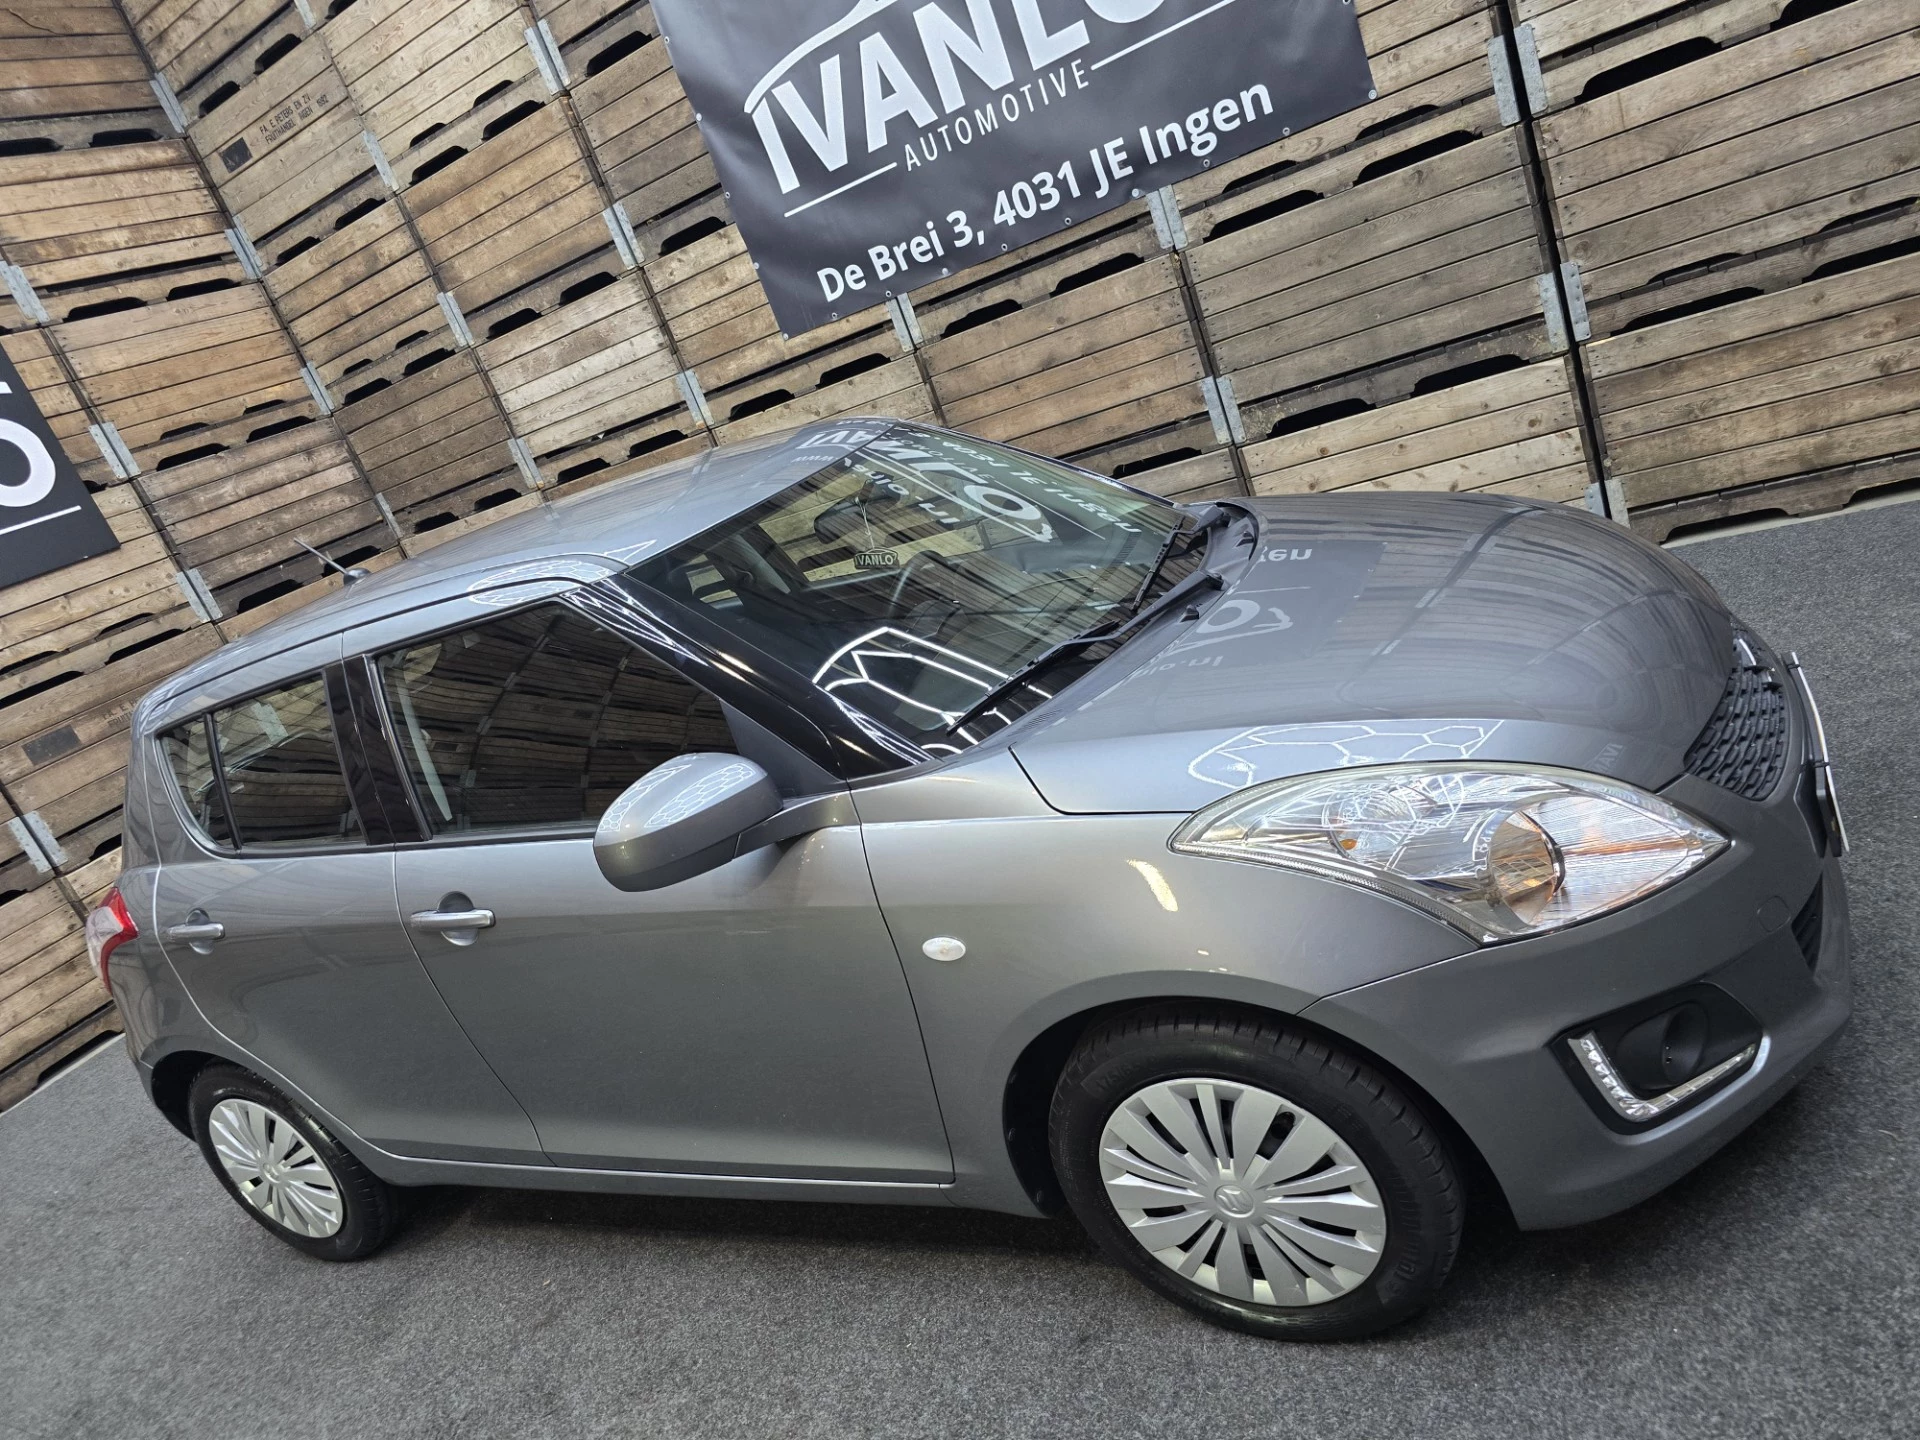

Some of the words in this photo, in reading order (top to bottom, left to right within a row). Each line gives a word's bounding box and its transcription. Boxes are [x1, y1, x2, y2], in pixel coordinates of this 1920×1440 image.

[751, 0, 1164, 195] IVANL
[904, 58, 1090, 172] AUTOMOTIVE
[816, 266, 867, 303] De
[868, 220, 946, 283] Brei
[946, 209, 986, 246] 3,
[993, 160, 1082, 228] 4031
[1089, 136, 1135, 200] JE
[1139, 83, 1274, 158] Ingen
[855, 554, 894, 566] IVANLO
